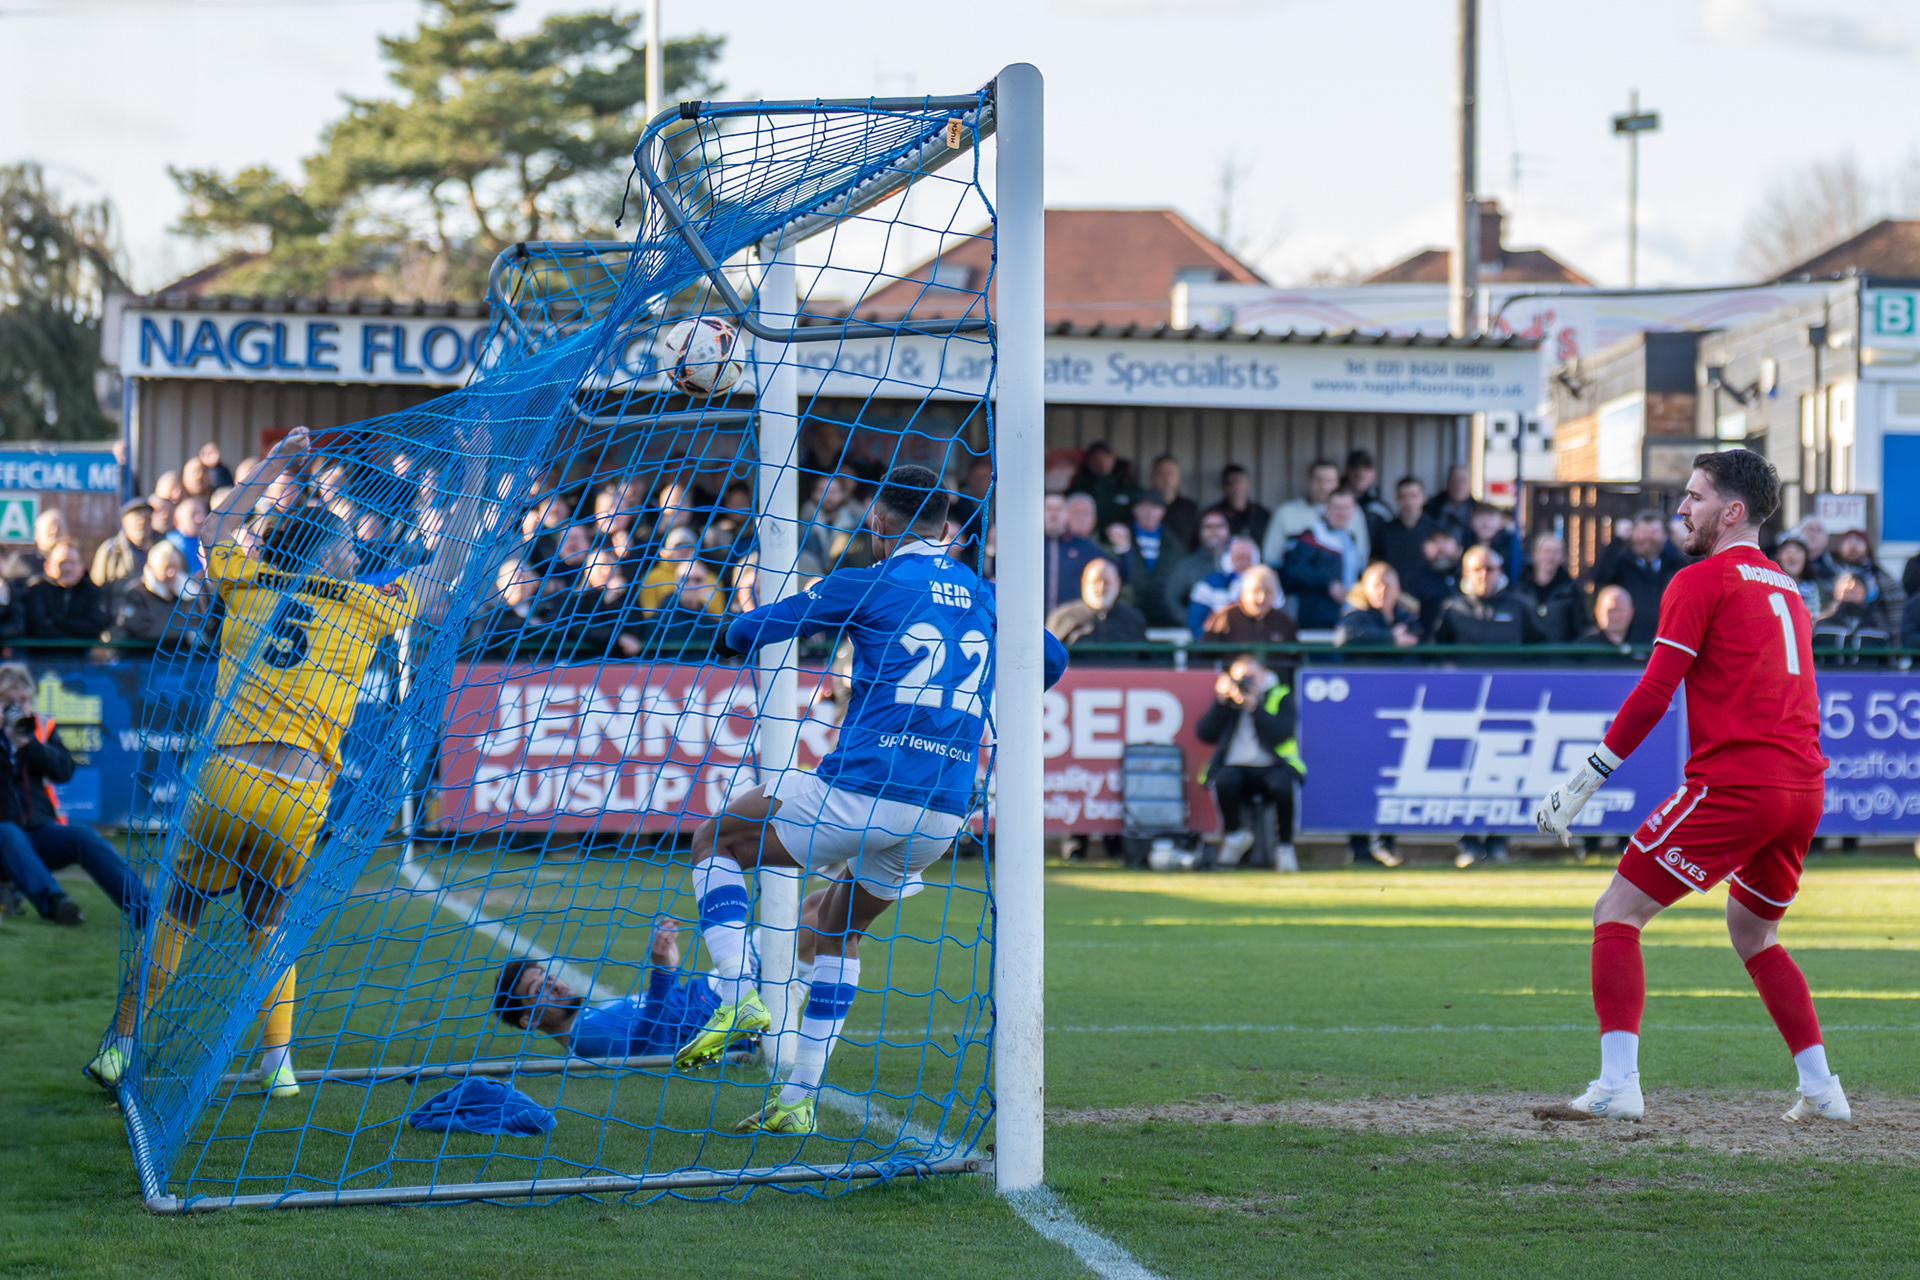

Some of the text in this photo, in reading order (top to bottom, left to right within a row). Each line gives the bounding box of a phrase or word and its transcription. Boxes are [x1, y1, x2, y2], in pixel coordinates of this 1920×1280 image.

[949, 122, 959, 144] HUCK
[1879, 296, 1912, 333] B
[139, 316, 340, 372] NAGLE
[896, 345, 925, 380] &
[1107, 350, 1279, 392] Specialists
[0, 502, 30, 539] A
[1821, 499, 1862, 519] EXIT
[929, 581, 972, 609] REID
[1768, 592, 1801, 675] 1
[894, 621, 991, 719] 22
[1821, 691, 1855, 740] 5
[473, 764, 692, 815] RUISLIP
